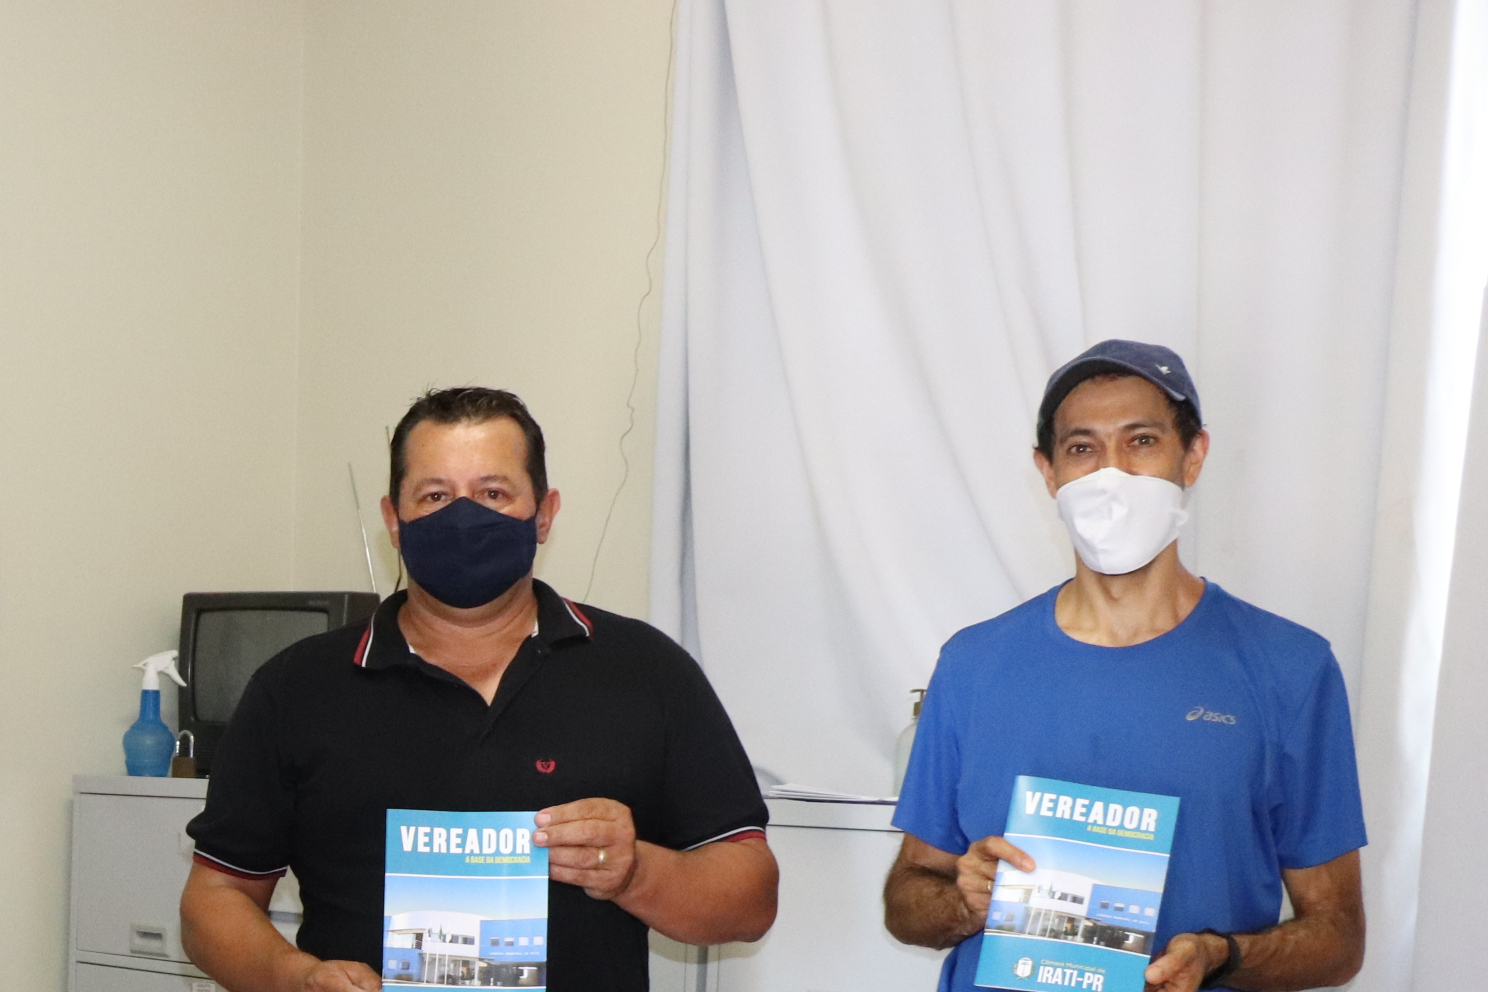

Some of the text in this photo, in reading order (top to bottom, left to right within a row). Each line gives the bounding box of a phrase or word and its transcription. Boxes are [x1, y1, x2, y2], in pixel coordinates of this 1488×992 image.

[1025, 790, 1159, 832] VEREADOR
[400, 825, 531, 855] VEREADOR
[1036, 965, 1105, 992] IRATI-PR
